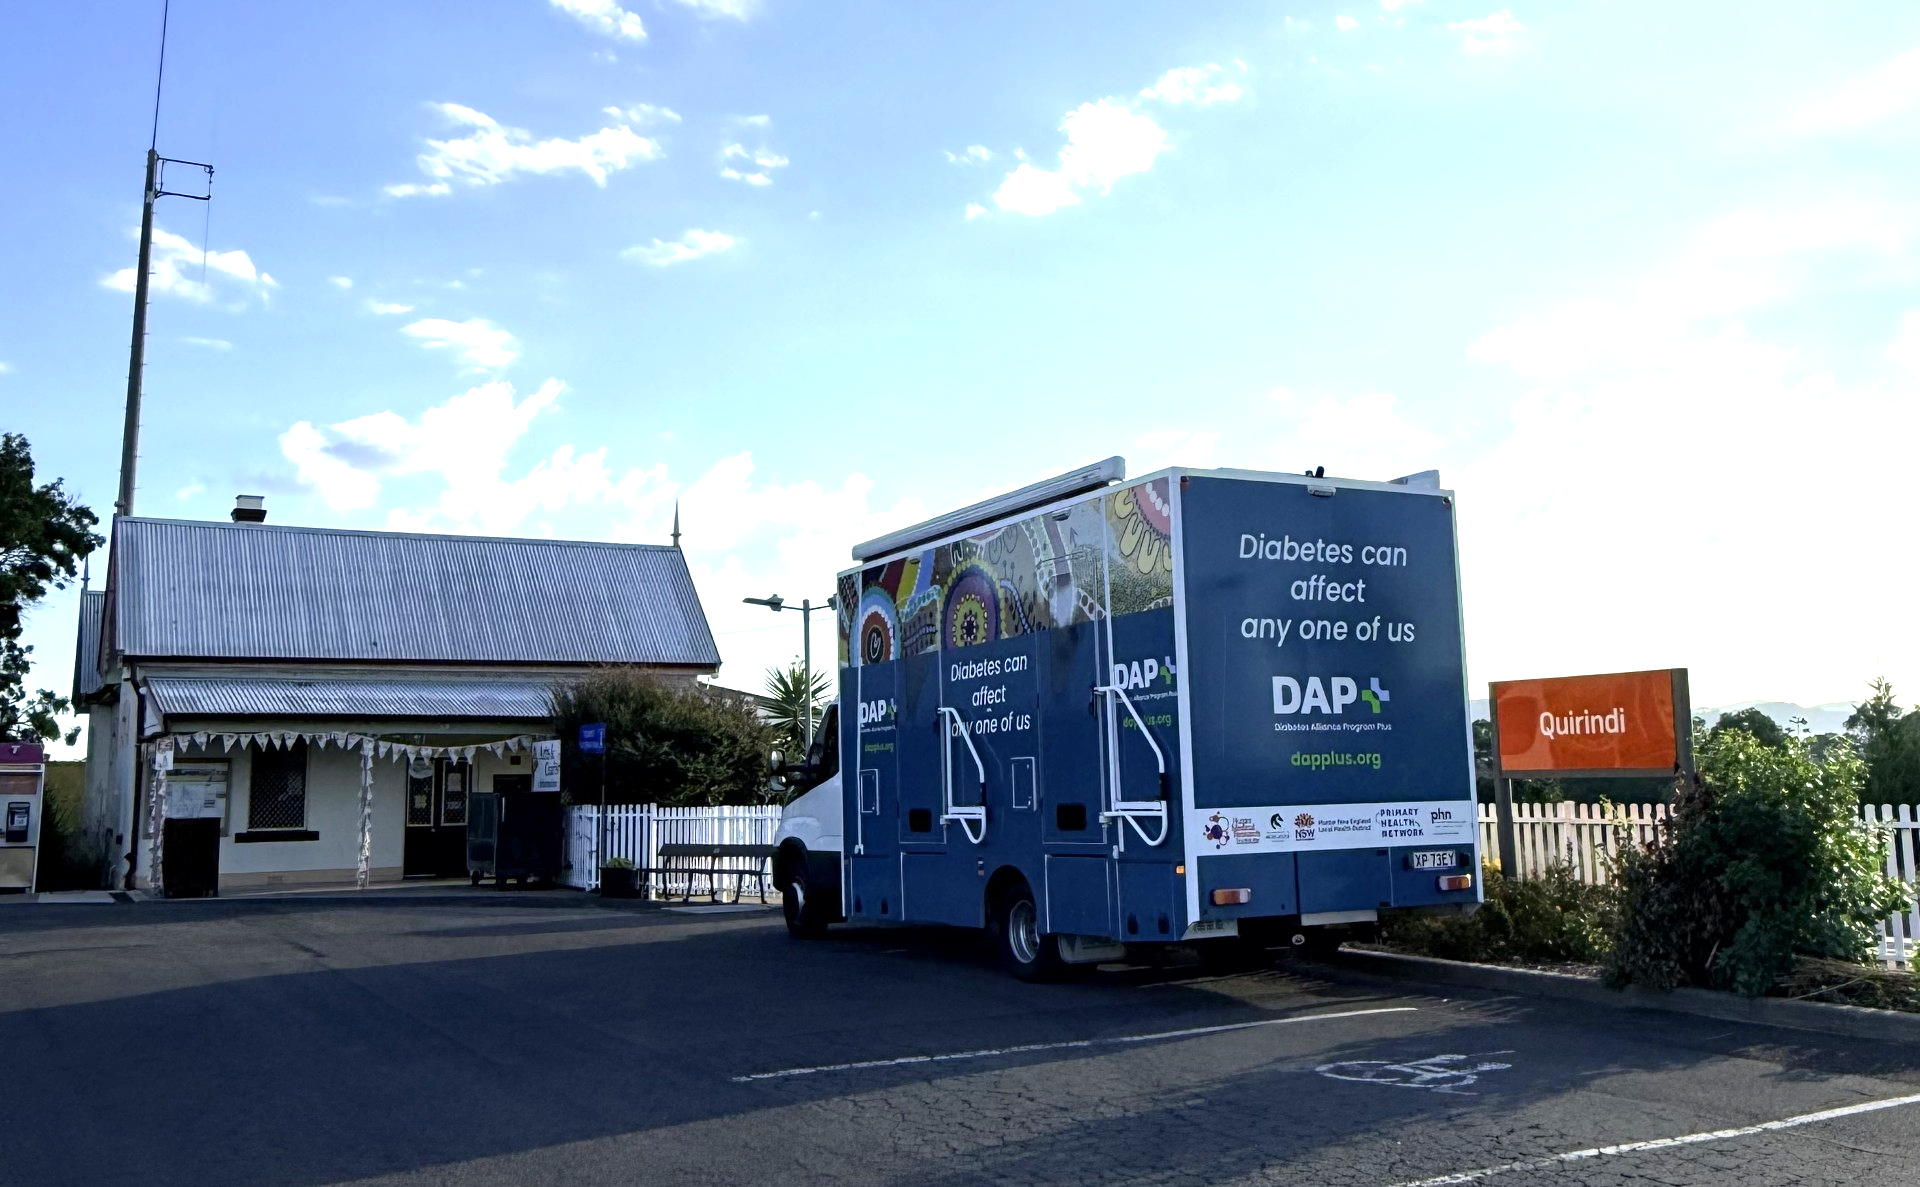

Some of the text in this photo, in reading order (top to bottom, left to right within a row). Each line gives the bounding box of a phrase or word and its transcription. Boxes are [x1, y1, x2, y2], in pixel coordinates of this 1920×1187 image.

[1239, 533, 1407, 566] Diabetes can
[1290, 574, 1366, 602] affect
[1241, 615, 1415, 647] any one of us
[951, 655, 1027, 681] Diabetes can
[972, 684, 1006, 706] affect
[1272, 676, 1358, 714] DAP
[975, 718, 998, 735] one
[1001, 711, 1014, 732] of
[1016, 714, 1031, 731] us
[1343, 723, 1375, 733] Program
[1540, 707, 1626, 740] Quirindi
[1290, 750, 1381, 771] dapplus.org
[1380, 808, 1419, 817] PRIMARY
[1381, 818, 1415, 828] HEALTH
[1430, 807, 1452, 824] phn
[1295, 828, 1315, 839] NSW
[1381, 828, 1424, 838] NETWORK
[1415, 853, 1428, 867] XP
